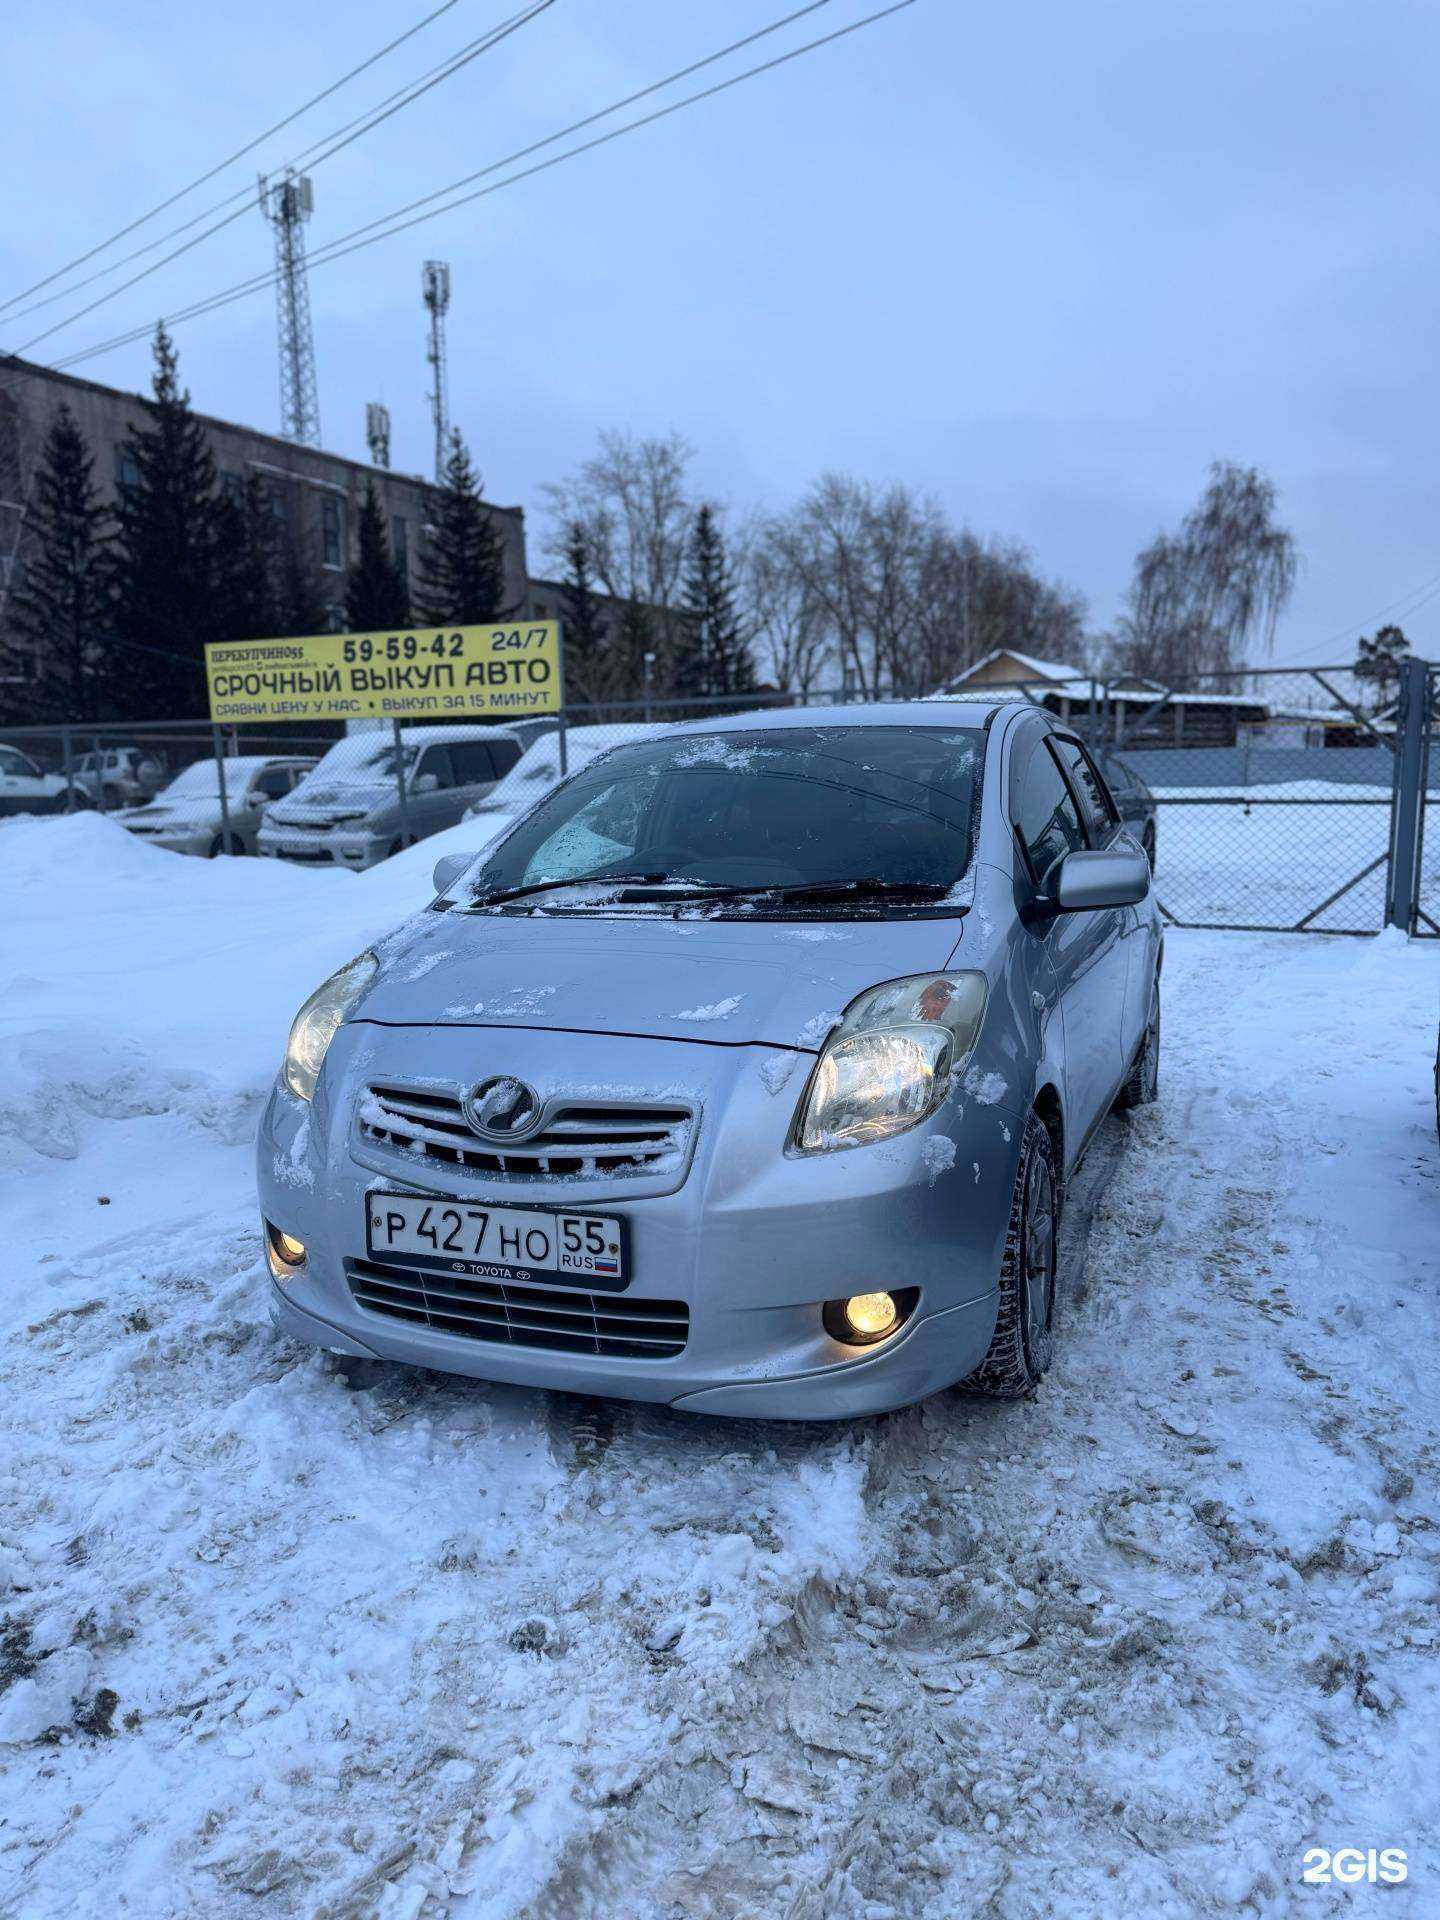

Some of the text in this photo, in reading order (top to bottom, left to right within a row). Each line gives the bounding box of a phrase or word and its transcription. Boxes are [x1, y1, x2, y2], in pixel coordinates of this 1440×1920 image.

[343, 633, 464, 663] 59-59-42
[491, 629, 548, 651] 24/7
[213, 659, 551, 697] СРОЧНЫЙ ВЫКУП АВТО
[216, 691, 551, 716] СРАВНИ ЦЕНУ У НАС ВЫКУП ЗА 15 МИНУТ
[564, 1219, 606, 1255] 55
[470, 1265, 511, 1278] TOYOTA
[562, 1254, 593, 1269] RUS
